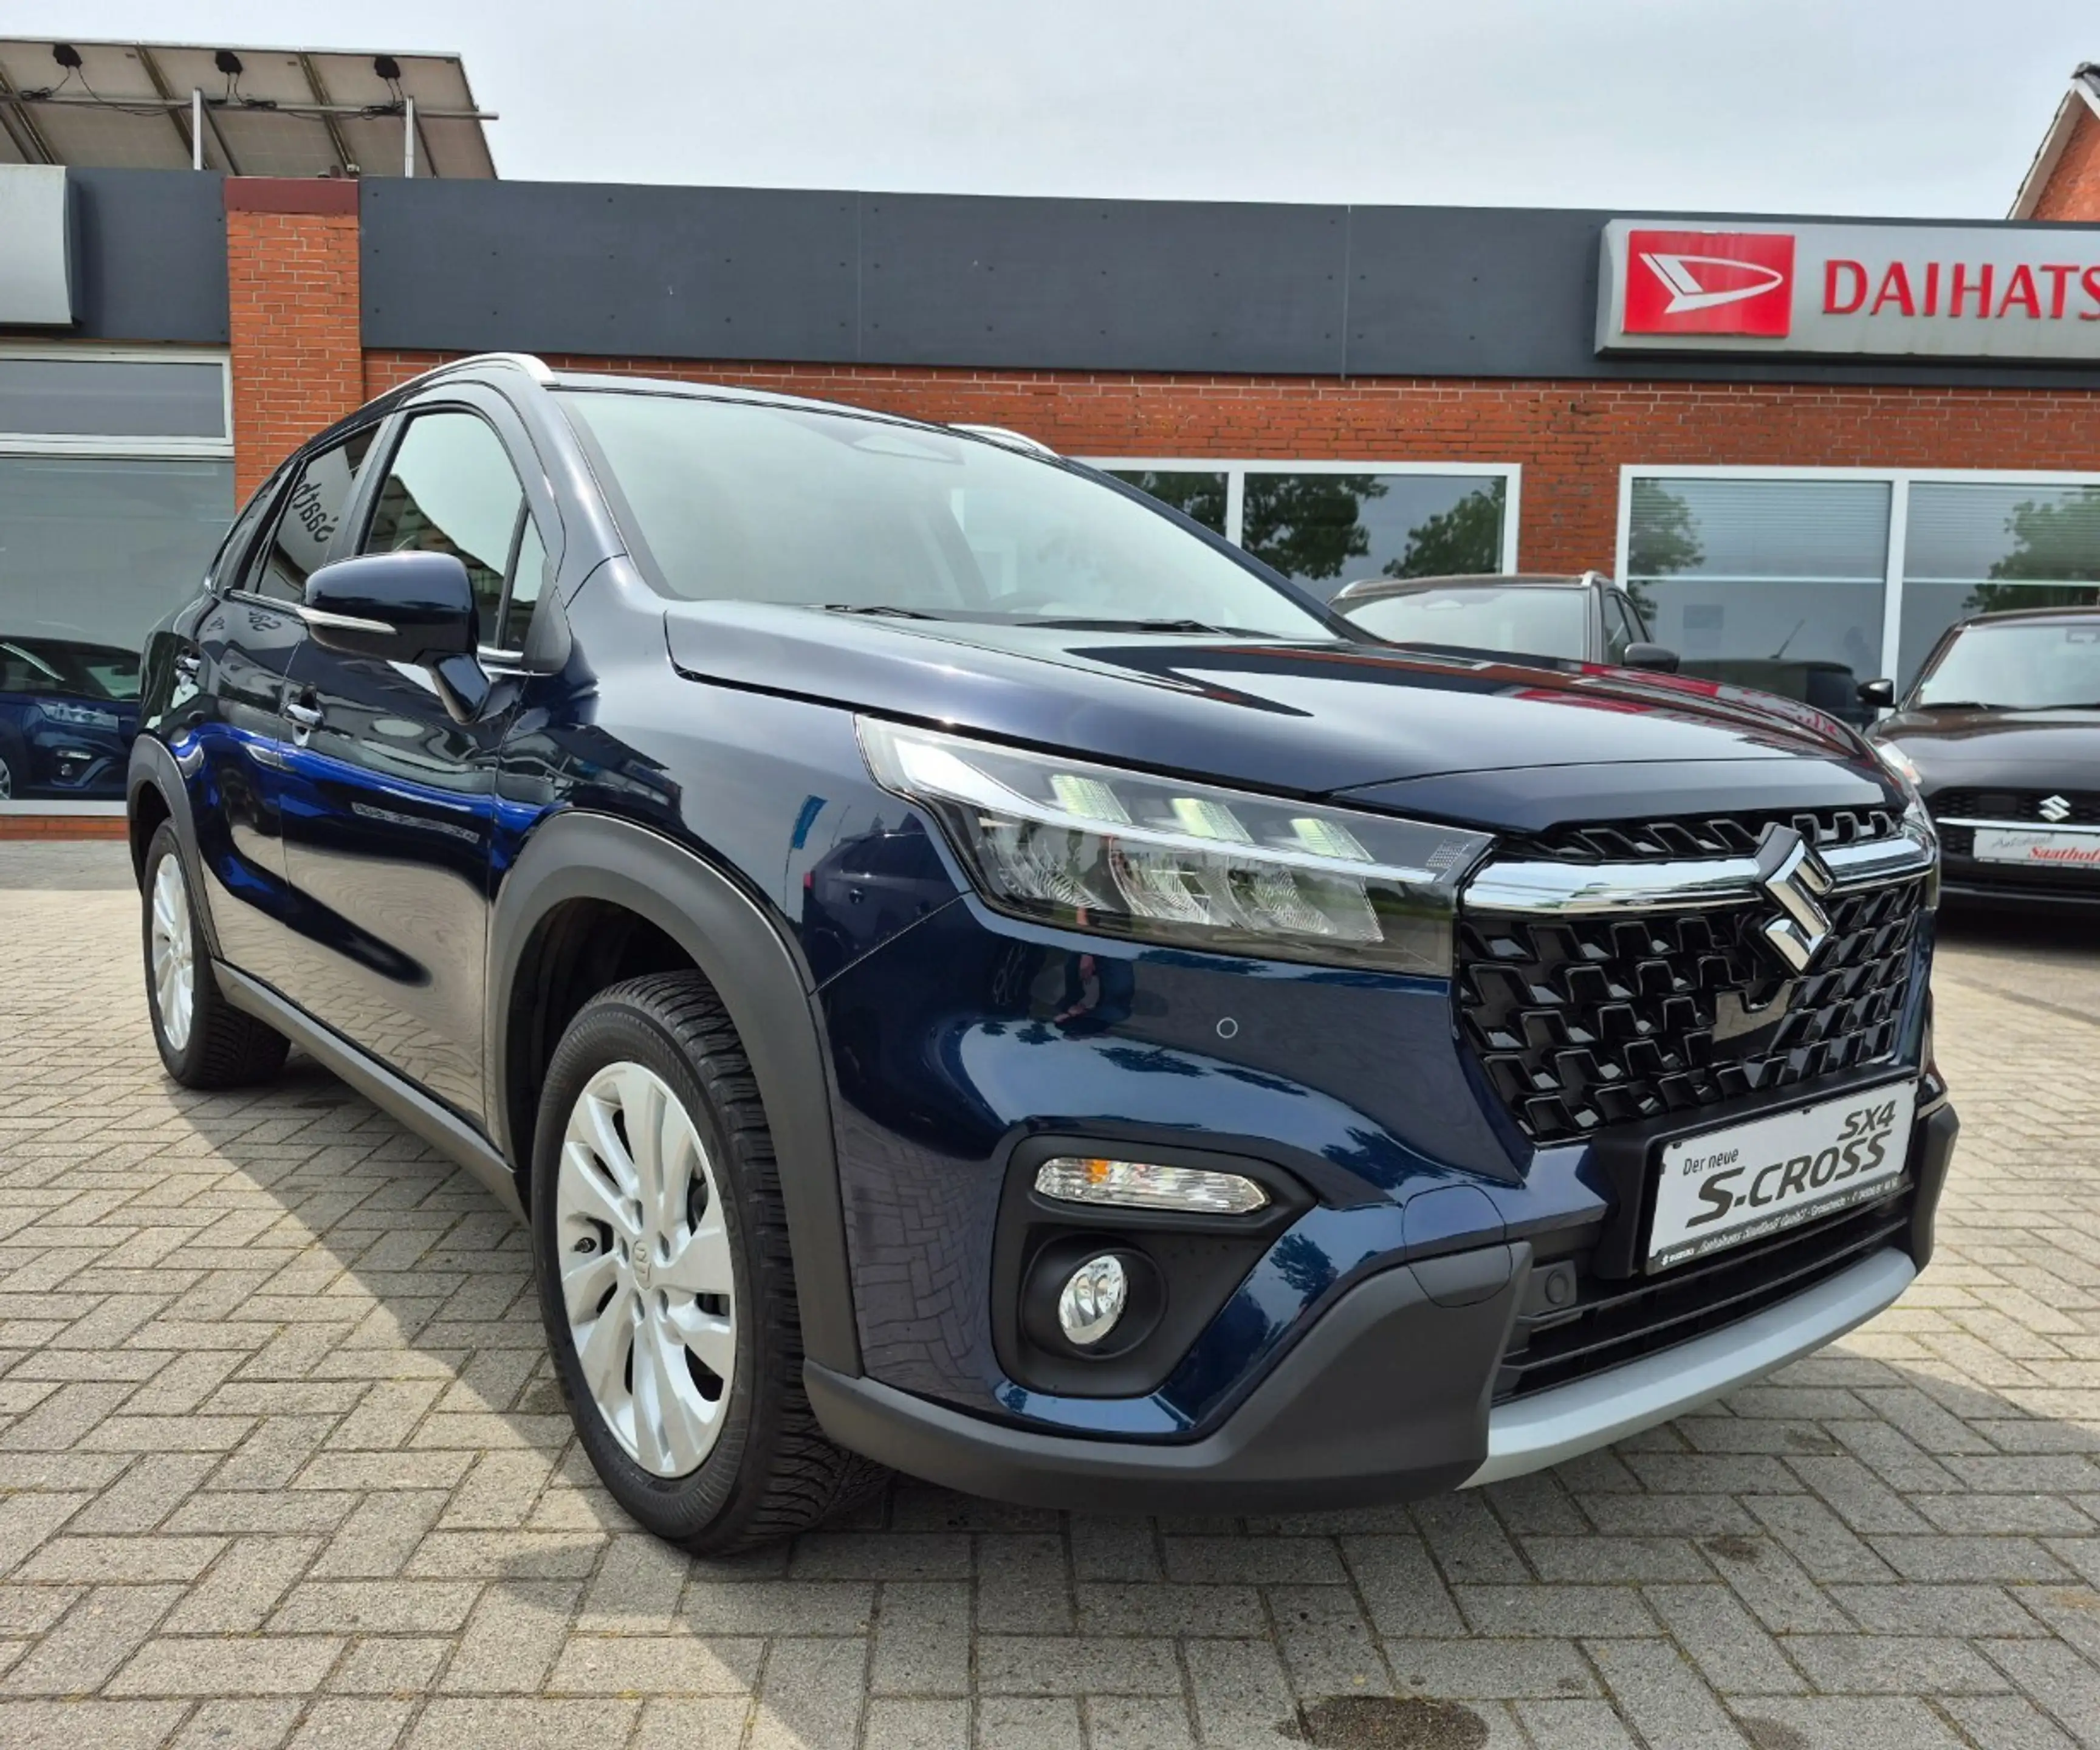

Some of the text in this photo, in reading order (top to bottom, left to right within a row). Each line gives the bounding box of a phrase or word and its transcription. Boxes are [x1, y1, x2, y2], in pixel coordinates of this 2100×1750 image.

[1823, 259, 2100, 321] DAIHATS
[2029, 846, 2100, 862] Saathof
[1837, 1099, 1896, 1141] SX4
[1683, 1148, 1740, 1176] Der neue
